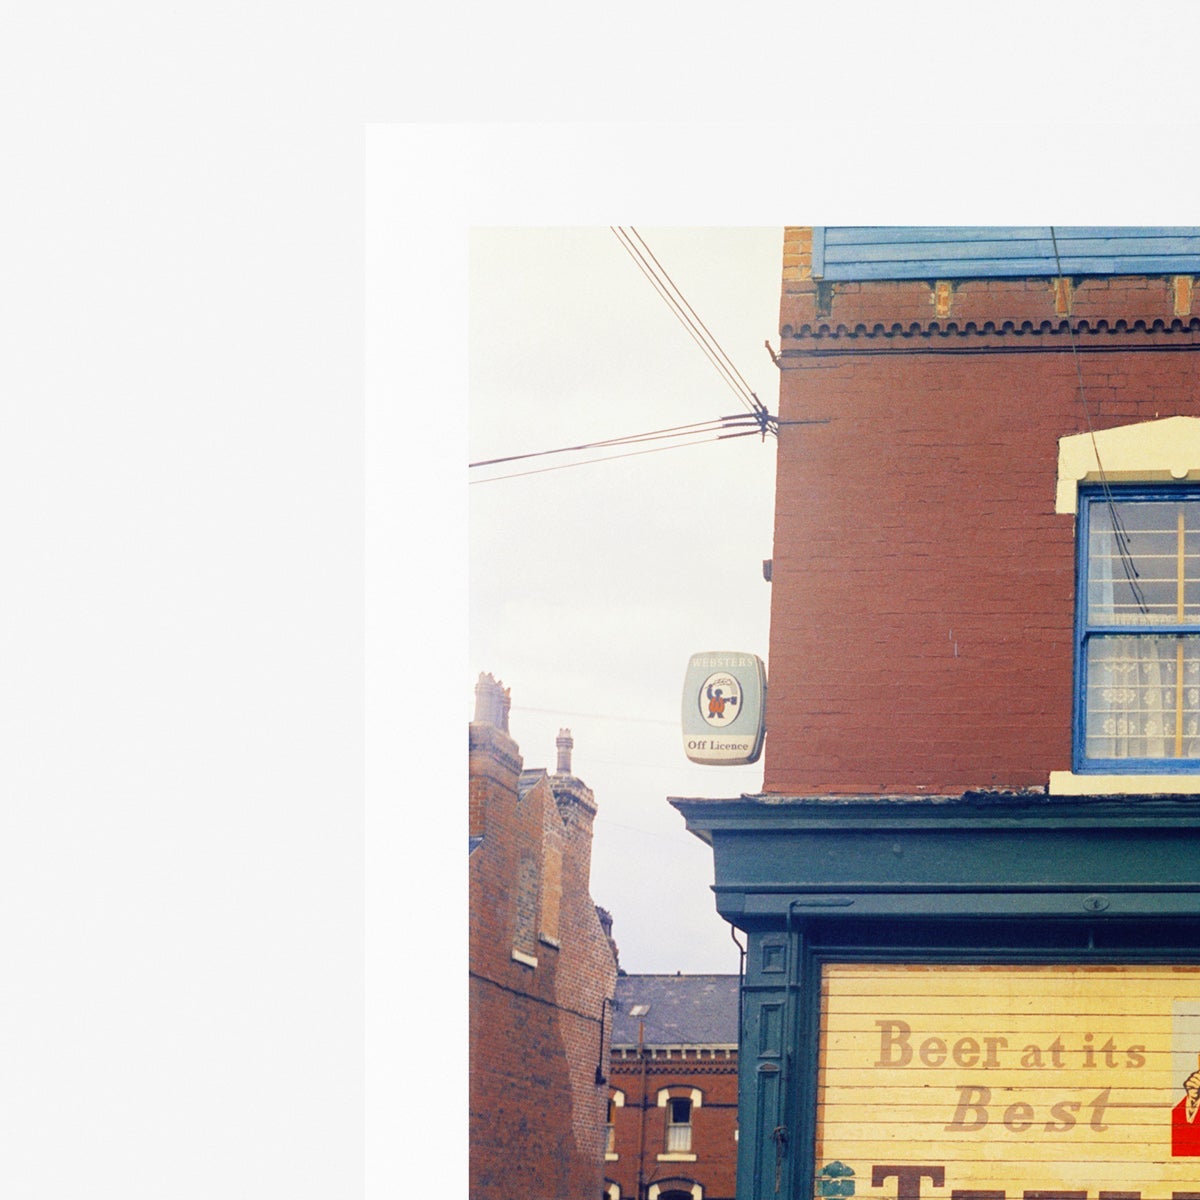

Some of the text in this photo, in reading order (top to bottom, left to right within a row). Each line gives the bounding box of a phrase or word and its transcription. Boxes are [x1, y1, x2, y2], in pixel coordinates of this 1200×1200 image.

[688, 740, 749, 751] Off Licence
[874, 1019, 1146, 1069] Beer at its
[944, 1084, 1173, 1132] Best
